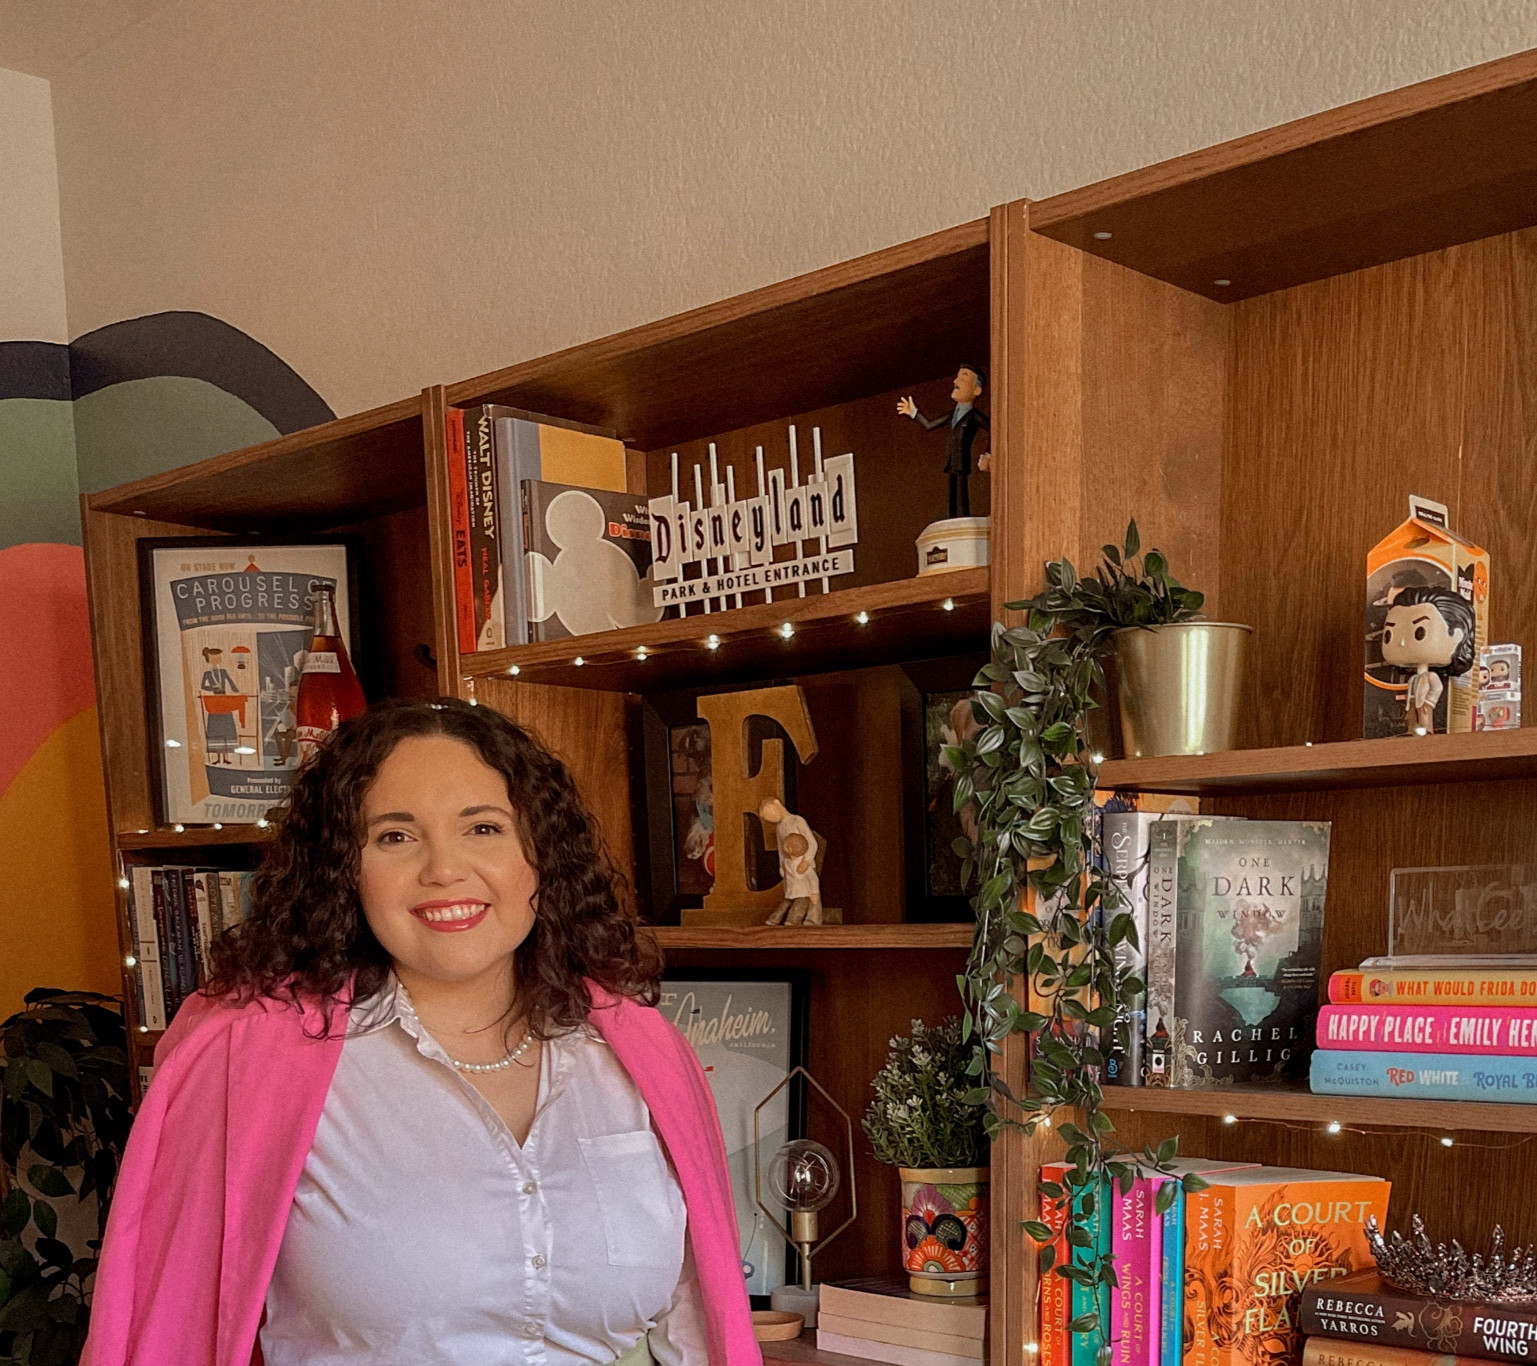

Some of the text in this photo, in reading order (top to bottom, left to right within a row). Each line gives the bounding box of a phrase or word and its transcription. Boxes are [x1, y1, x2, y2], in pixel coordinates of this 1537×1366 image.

[478, 415, 495, 539] WALT DISNEY
[651, 474, 845, 563] Disneyland
[456, 530, 467, 568] EATS
[177, 576, 298, 599] CAROUSEL
[662, 557, 839, 600] PARK & HOTEL ENTRANCE
[195, 593, 314, 612] PROGRESS
[231, 785, 263, 794] GENERAL
[204, 803, 275, 818] TOMORR
[1239, 858, 1270, 868] ONE
[1213, 876, 1295, 896] DARK
[1161, 878, 1172, 943] DARK
[1218, 908, 1286, 919] WINDOW
[1396, 981, 1537, 997] WHAT WOULD FRIDA DO
[1193, 1028, 1297, 1043] RACHEL
[1328, 1014, 1434, 1044] HAPPY PLACE
[1449, 1017, 1502, 1046] EMILY
[1197, 1049, 1291, 1064] GILLIG
[1337, 1063, 1366, 1071] CASEY
[1386, 1067, 1518, 1089] RED WHITE ROYAL
[1122, 1198, 1132, 1241] MAAS
[1135, 1190, 1144, 1239] SARAH
[1213, 1198, 1223, 1250] SARAH
[1244, 1201, 1372, 1229] A COURT
[1199, 1207, 1210, 1251] MAAS
[1289, 1237, 1317, 1256] OF
[1121, 1263, 1132, 1309] WINGS
[1054, 1288, 1063, 1333] COURT
[1134, 1292, 1143, 1342] COURT
[1316, 1298, 1385, 1317] REBECCA
[1195, 1301, 1206, 1348] SILVER
[1320, 1318, 1379, 1337] YARROS
[1473, 1317, 1537, 1341] FOURTH
[1043, 1324, 1052, 1366] ROSES
[1121, 1330, 1131, 1364] RUIN
[1482, 1336, 1529, 1356] WING
